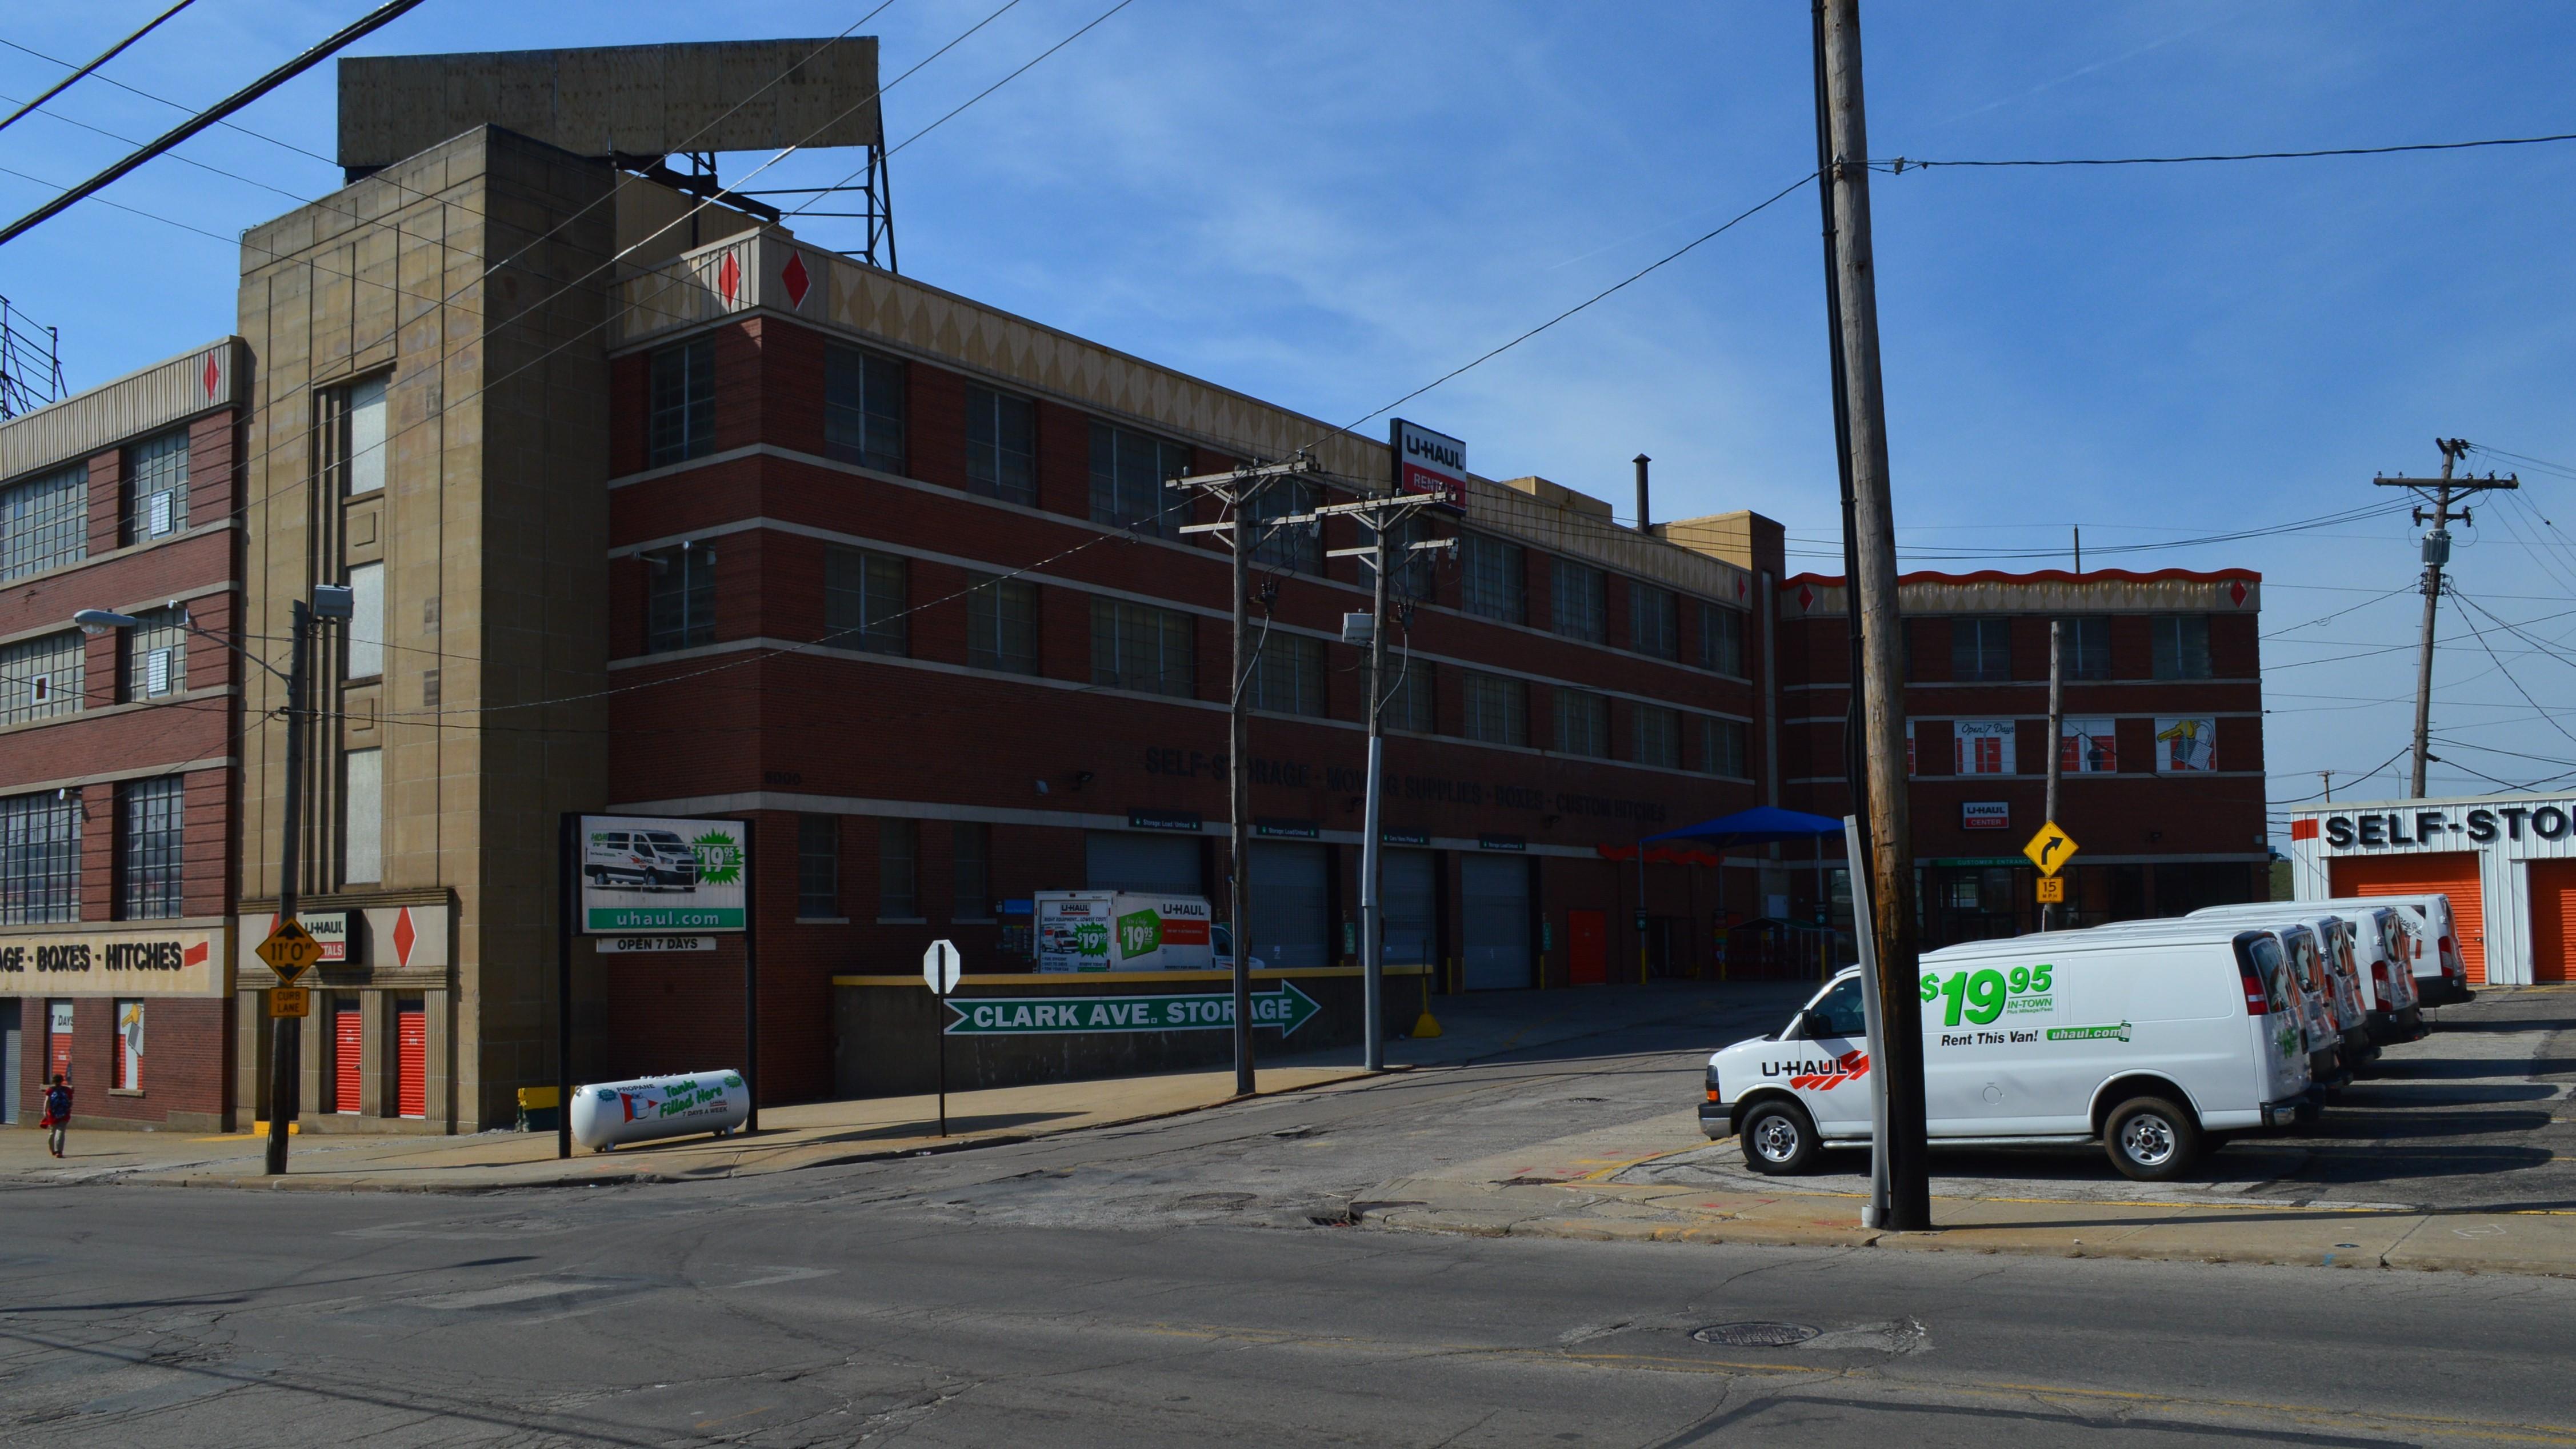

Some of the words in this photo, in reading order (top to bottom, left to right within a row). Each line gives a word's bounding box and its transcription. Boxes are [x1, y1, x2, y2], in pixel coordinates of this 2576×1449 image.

[1407, 435, 1463, 471] U-HAUL
[1414, 473, 1454, 494] RENTL
[1962, 723, 1983, 735] Open
[1985, 724, 1991, 733] 7
[1994, 723, 2014, 734] Days
[1146, 746, 1311, 787] SELF-SRAGE
[1327, 767, 1399, 796] MOVG
[1556, 793, 1610, 817] CUSTOM
[1614, 800, 1666, 823] HITCHES
[2326, 806, 2576, 847] SELF-STO
[2043, 882, 2057, 892] 15
[1163, 904, 1204, 915] U-HAUL
[617, 911, 719, 926] uhaul.com
[305, 920, 343, 935] U-HAUL
[321, 945, 343, 956] TALS
[618, 939, 652, 950] OPEN
[658, 939, 663, 949] 7
[667, 939, 698, 949] DAYS
[0, 946, 24, 972] GE
[37, 944, 90, 971] BOXES
[106, 942, 182, 971] HITCHES
[278, 991, 301, 1000] CURB
[278, 1004, 300, 1013] LANE
[2007, 998, 2053, 1009] IN-TOWN
[974, 1004, 1078, 1028] CLARK
[1089, 1003, 1157, 1026] AVE.
[1941, 1032, 1973, 1046] Rent
[1977, 1032, 2005, 1044] This
[2010, 1030, 2038, 1043] Van!
[2051, 1028, 2122, 1039] uhaul.com
[1762, 1059, 1847, 1076] U-HAUL
[663, 1080, 698, 1097] Tanks
[659, 1095, 694, 1118] Filled
[697, 1087, 723, 1104] Here
